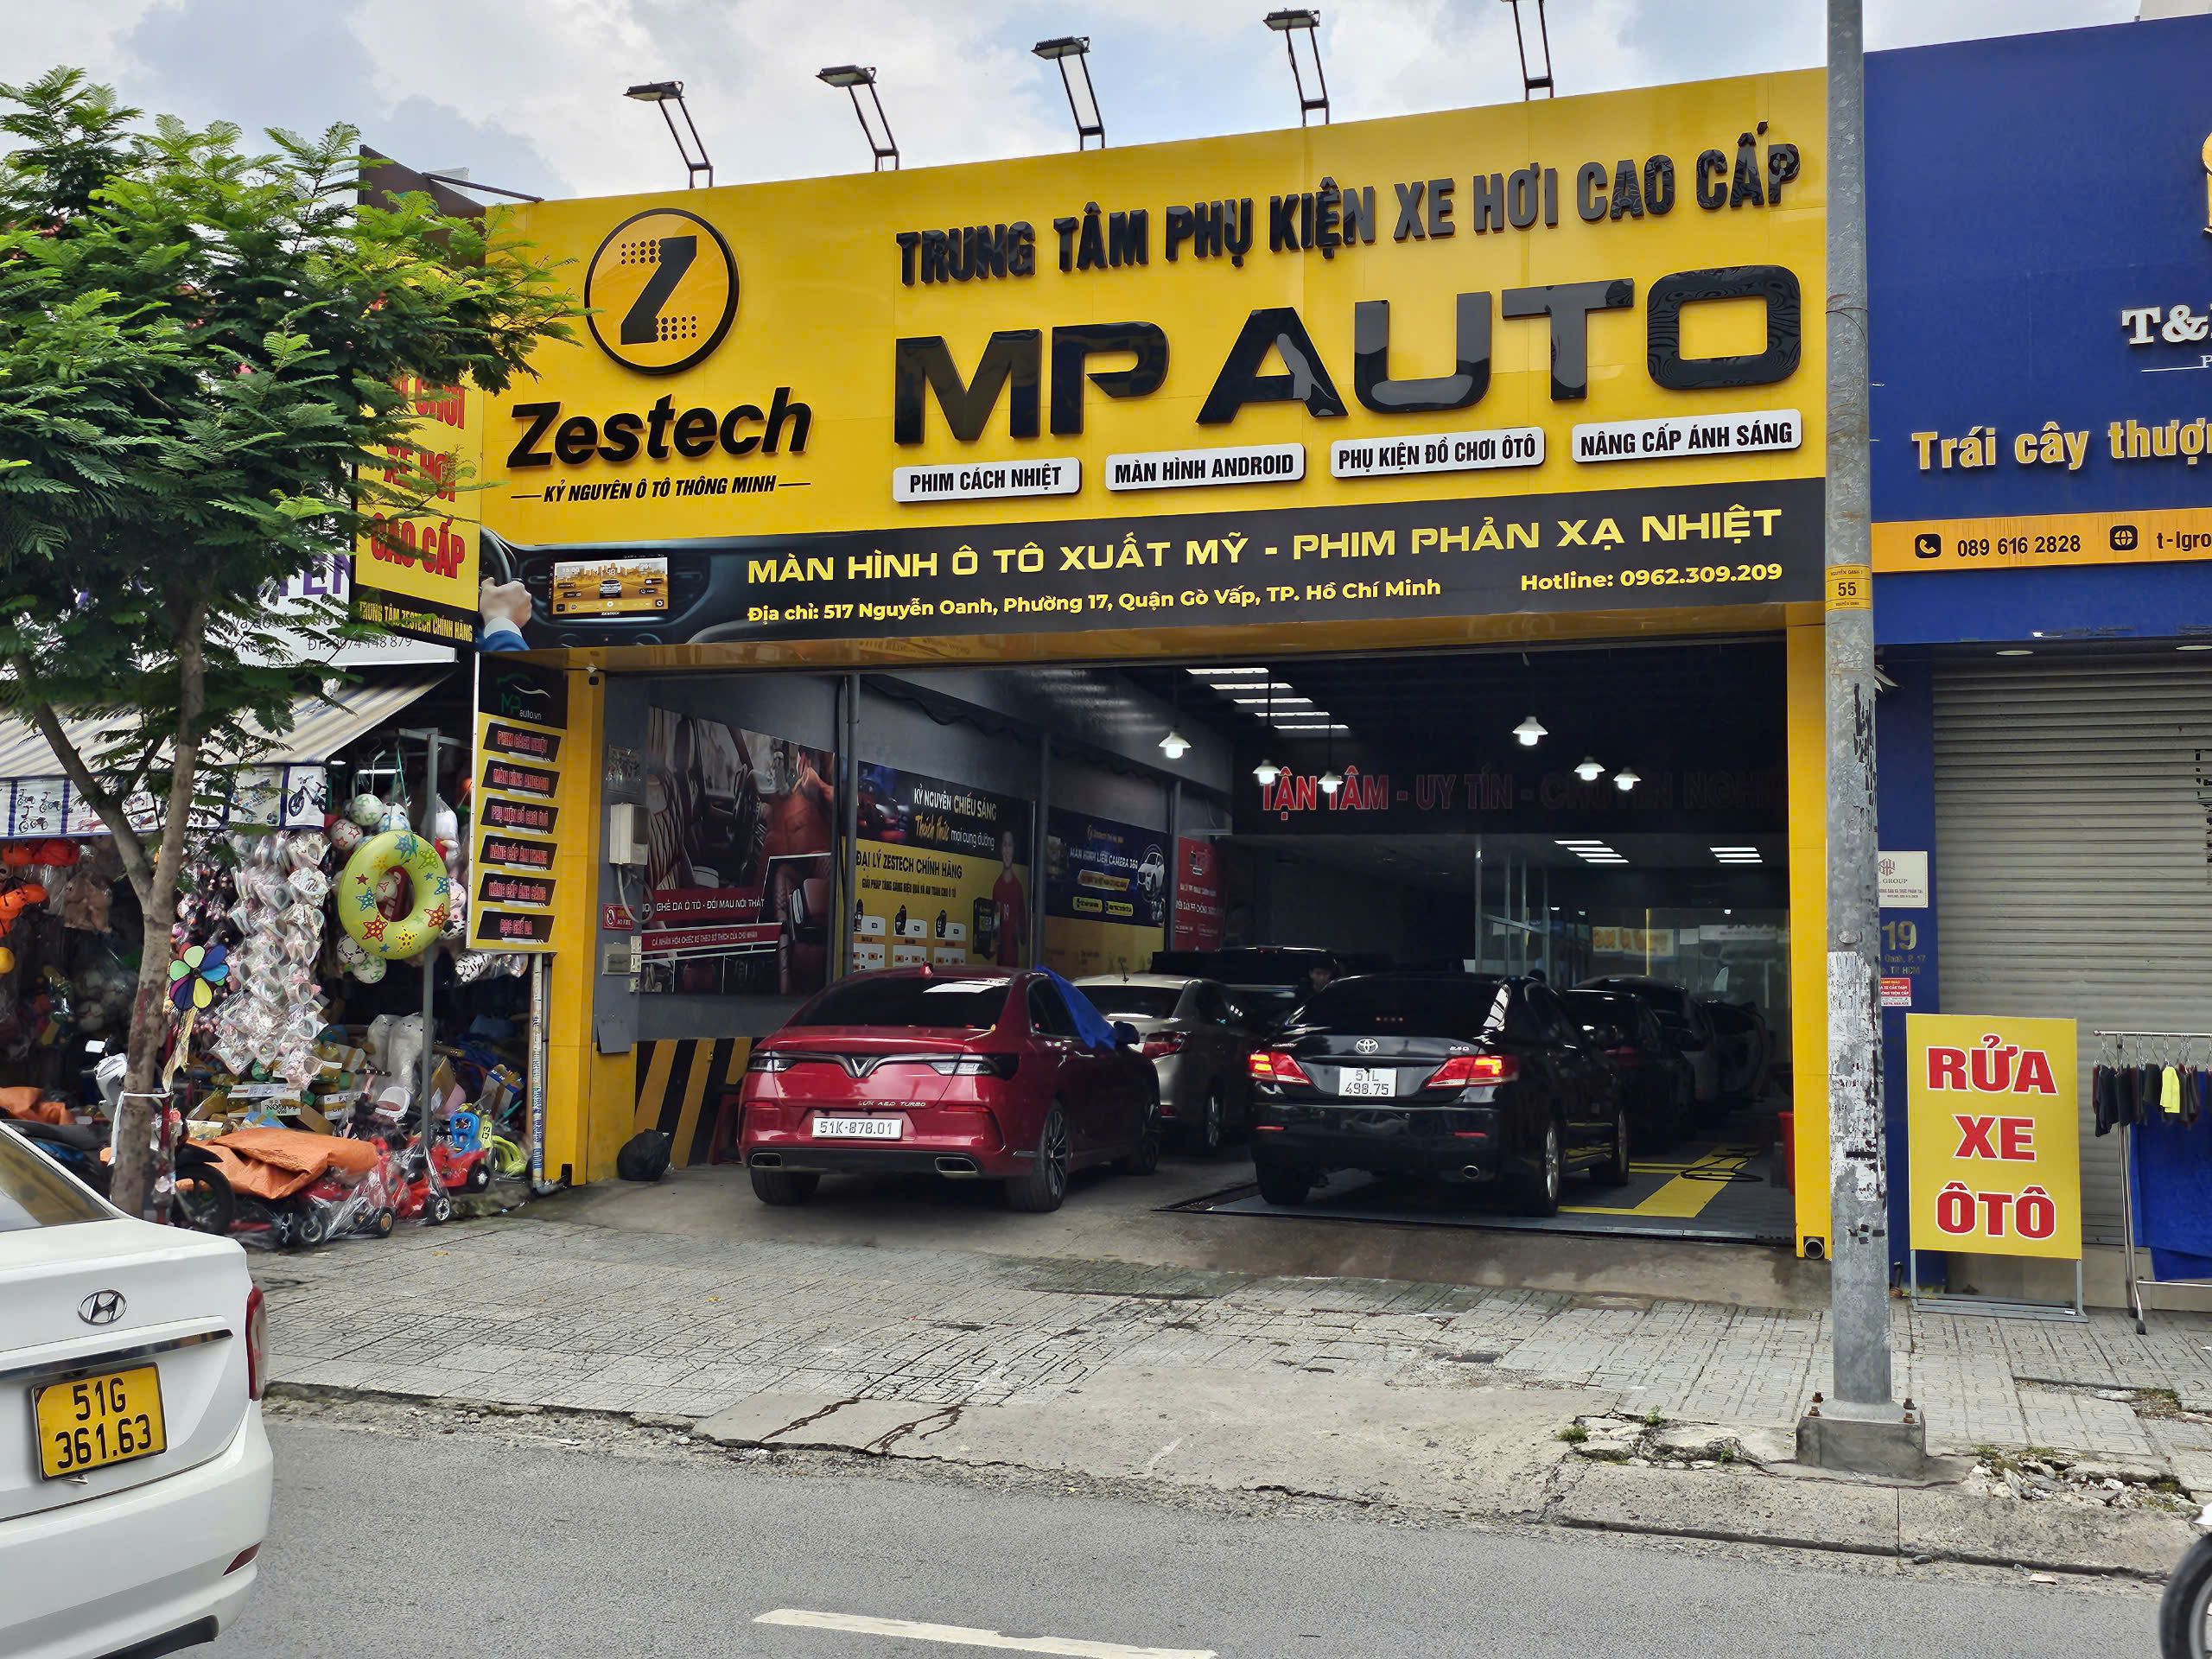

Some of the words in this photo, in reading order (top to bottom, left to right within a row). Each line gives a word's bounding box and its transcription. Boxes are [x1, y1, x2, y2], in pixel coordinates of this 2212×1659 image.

[895, 220, 1036, 286] TRUNG
[1052, 200, 1149, 272] TÂM
[1166, 196, 1255, 267] PHỤ
[1269, 176, 1376, 260] KIỆN
[1393, 177, 1456, 243] XE
[1472, 162, 1559, 234] HƠI
[1576, 154, 1675, 222] CAO
[1696, 120, 1800, 211] CẤP
[894, 321, 1171, 445] MP
[1195, 264, 1802, 426] AUTO
[506, 385, 815, 469] Zestech
[1581, 430, 1636, 456] NÂNG
[1643, 423, 1681, 453] CẤP
[1688, 424, 1730, 449] ÁNH
[1736, 420, 1792, 447] SÁNG
[1911, 422, 1997, 471] Trái
[2013, 420, 2091, 472] cây
[2108, 417, 2212, 465] thượ
[1115, 460, 1157, 484] MÀN
[1163, 457, 1206, 480] HÌNH
[1211, 454, 1294, 478] ANDROID
[1339, 448, 1373, 473] PHỤ
[1379, 442, 1420, 470] KIỆN
[1425, 436, 1449, 464] ĐỒ
[1454, 439, 1496, 462] CHƠI
[1502, 434, 1535, 460] ÔTÔ
[543, 479, 567, 503] KỶ
[568, 479, 633, 502] NGUYÊN
[635, 478, 647, 499] Ô
[652, 477, 671, 499] TÔ
[676, 474, 728, 497] THÔNG
[731, 475, 778, 494] MINH
[910, 473, 954, 493] PHIM
[960, 467, 1006, 491] CÁCH
[1011, 463, 1062, 490] NHIỆT
[372, 512, 416, 569] CAO
[423, 518, 466, 579] CẤP
[747, 553, 835, 584] MÀN
[848, 549, 938, 580] HÌNH
[952, 544, 977, 575] Ô
[993, 541, 1045, 574] TÔ
[1058, 531, 1171, 571] XUẤT
[1186, 531, 1249, 566] MỸ
[1294, 530, 1395, 561] PHIM
[1411, 517, 1540, 554] PHẢN
[1556, 518, 1625, 550] XẠ
[1642, 504, 1783, 543] NHIỆT
[1956, 537, 1990, 558] 089
[1997, 536, 2030, 556] 616
[2034, 533, 2082, 555] 2828
[1521, 570, 1614, 591] Hotline:
[1619, 563, 1783, 587] 0962.309.209
[1838, 582, 1857, 596] 55
[747, 604, 779, 625] Địa
[784, 602, 819, 620] chỉ:
[823, 603, 854, 619] 517
[859, 597, 934, 620] Nguyễn
[938, 598, 999, 616] Oanh,
[1003, 595, 1084, 613] Phường
[1088, 594, 1113, 611] 17,
[1118, 592, 1174, 612] Quận
[1180, 589, 1210, 607] Gò
[1213, 584, 1262, 607] Vấp,
[1266, 587, 1300, 602] TP.
[1306, 581, 1337, 601] Hồ
[1342, 581, 1380, 599] Chí
[1385, 578, 1442, 597] Minh
[882, 854, 914, 874] ZESTECH
[915, 856, 940, 876] CHÍNH
[1881, 920, 1917, 950] 19
[1355, 1069, 1380, 1082] 51L
[1926, 1033, 2059, 1096] RỬA
[1344, 1083, 1389, 1096] 498.75
[1952, 1114, 2037, 1162] XE
[1935, 1180, 2057, 1240] ÔTÔ
[73, 1377, 127, 1421] 51G
[54, 1413, 153, 1469] 361.63
